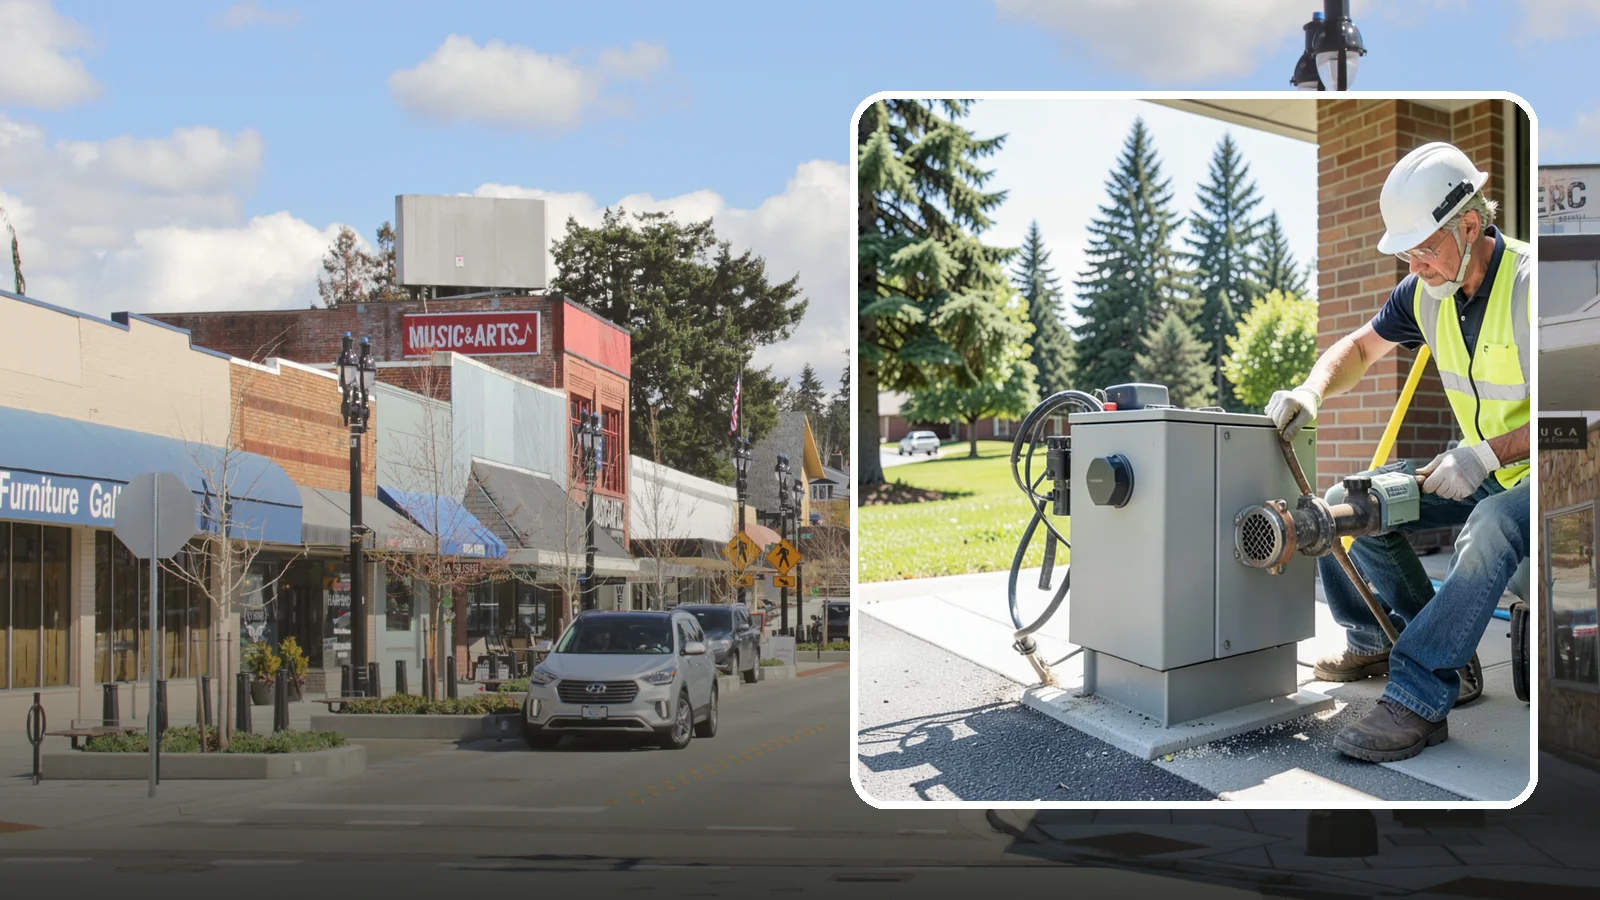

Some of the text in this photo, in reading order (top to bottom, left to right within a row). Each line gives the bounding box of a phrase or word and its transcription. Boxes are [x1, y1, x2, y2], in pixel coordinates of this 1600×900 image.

[409, 323, 519, 348] MUSIC&ARTS
[0, 471, 121, 519] Furniture Gal
[453, 563, 479, 574] SUSHI
